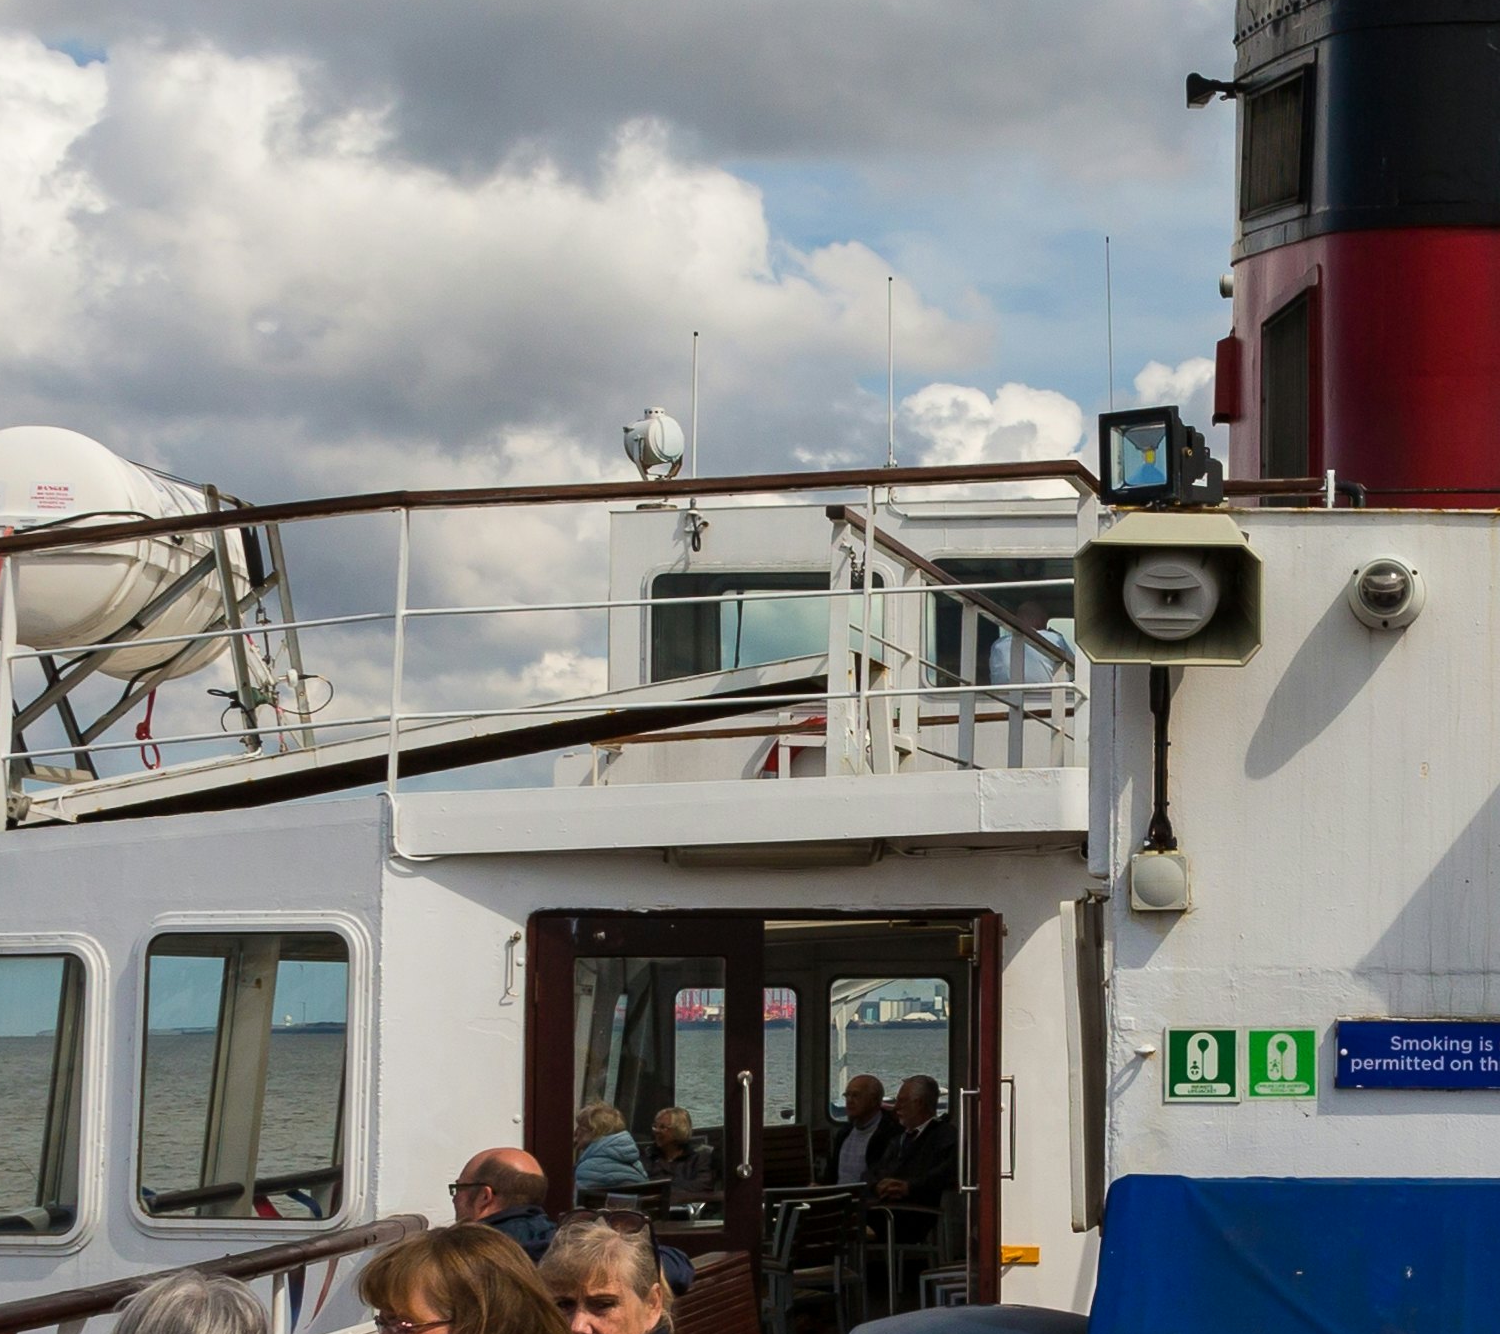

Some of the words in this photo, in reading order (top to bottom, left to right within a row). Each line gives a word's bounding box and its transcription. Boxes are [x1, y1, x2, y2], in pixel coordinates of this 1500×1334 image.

[1390, 1035, 1473, 1054] Smoking
[1479, 1036, 1493, 1051] is
[1351, 1055, 1445, 1072] permitted
[1450, 1059, 1474, 1071] on
